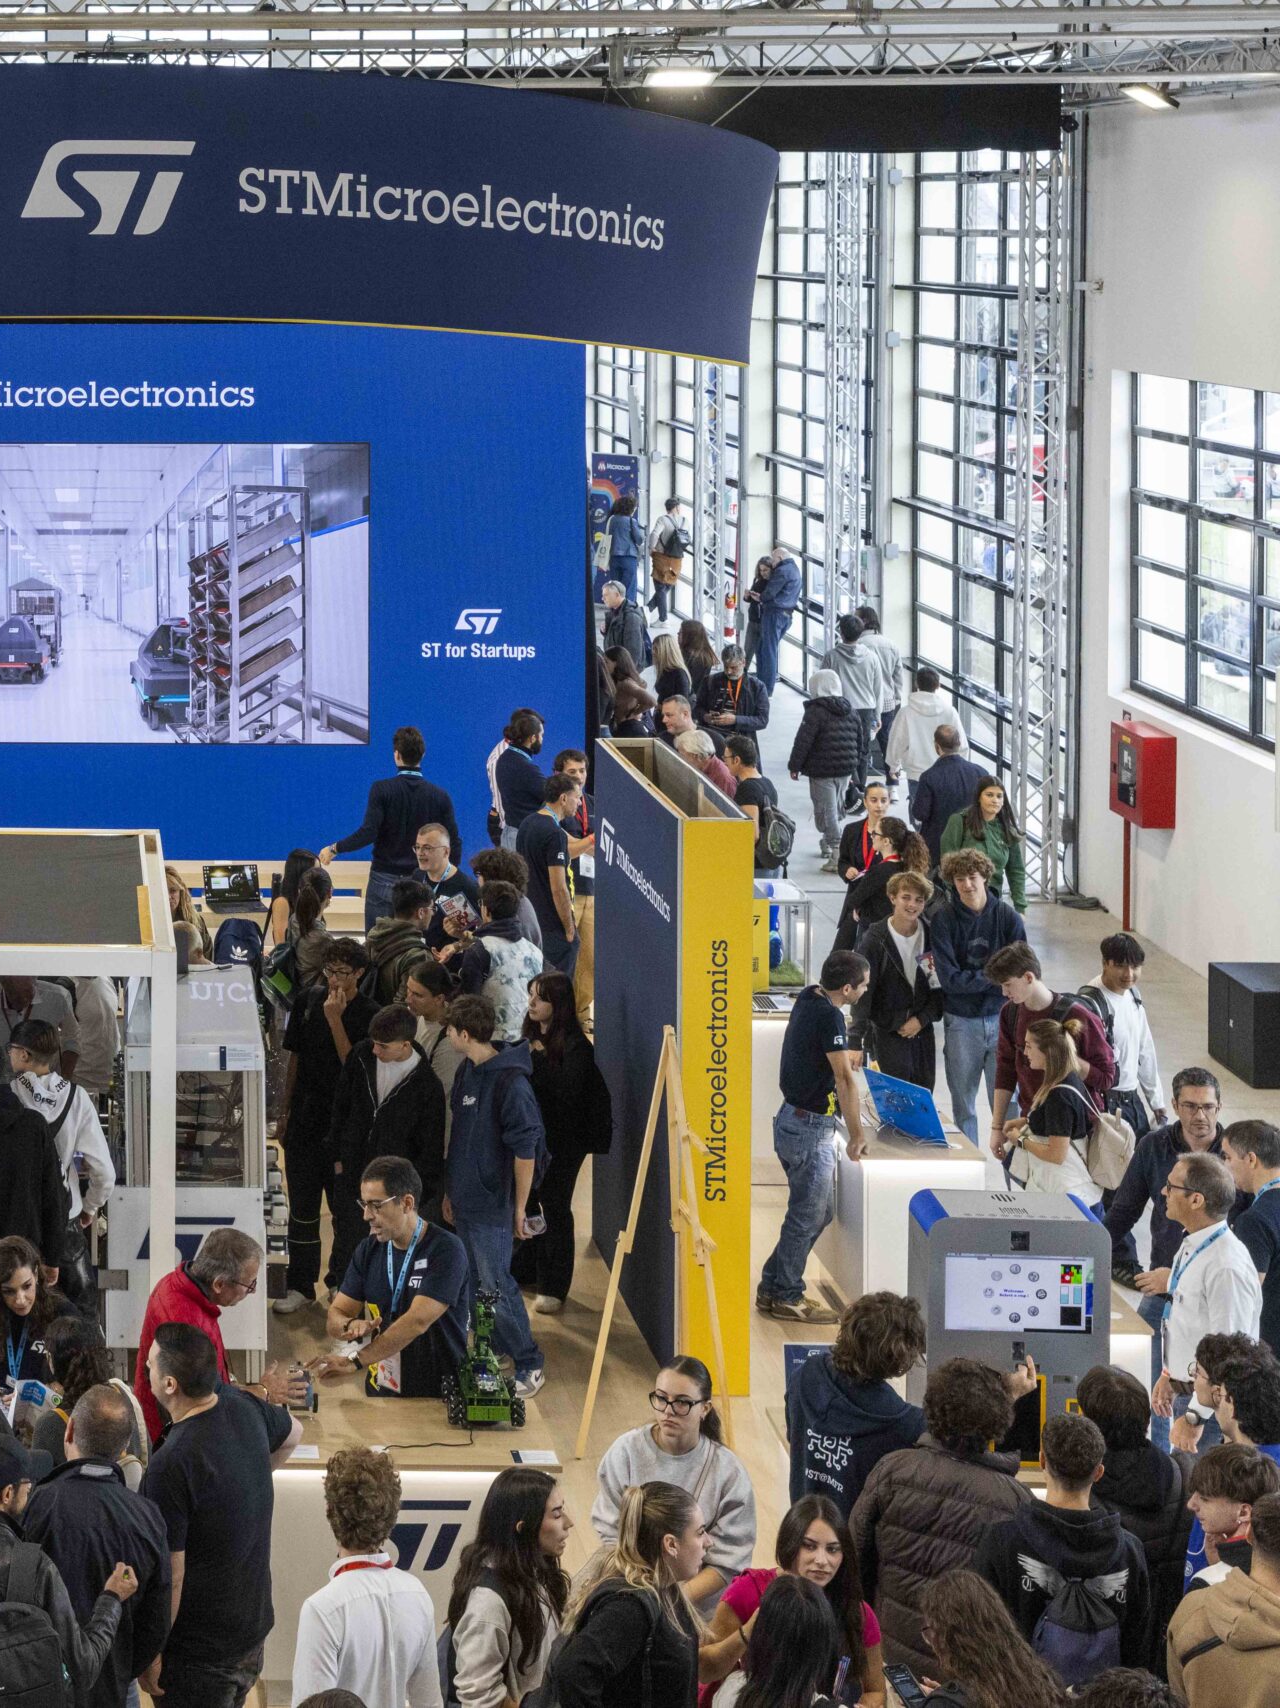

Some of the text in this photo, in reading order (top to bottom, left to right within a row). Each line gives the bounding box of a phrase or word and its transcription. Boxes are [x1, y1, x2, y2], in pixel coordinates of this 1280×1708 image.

[20, 139, 196, 235] ST
[238, 167, 665, 251] STMicroelectronics
[421, 643, 536, 661] ST for Startups
[455, 609, 502, 634] ST
[616, 844, 671, 923] STMicroelectronics
[705, 939, 728, 1202] STMicroelectronics
